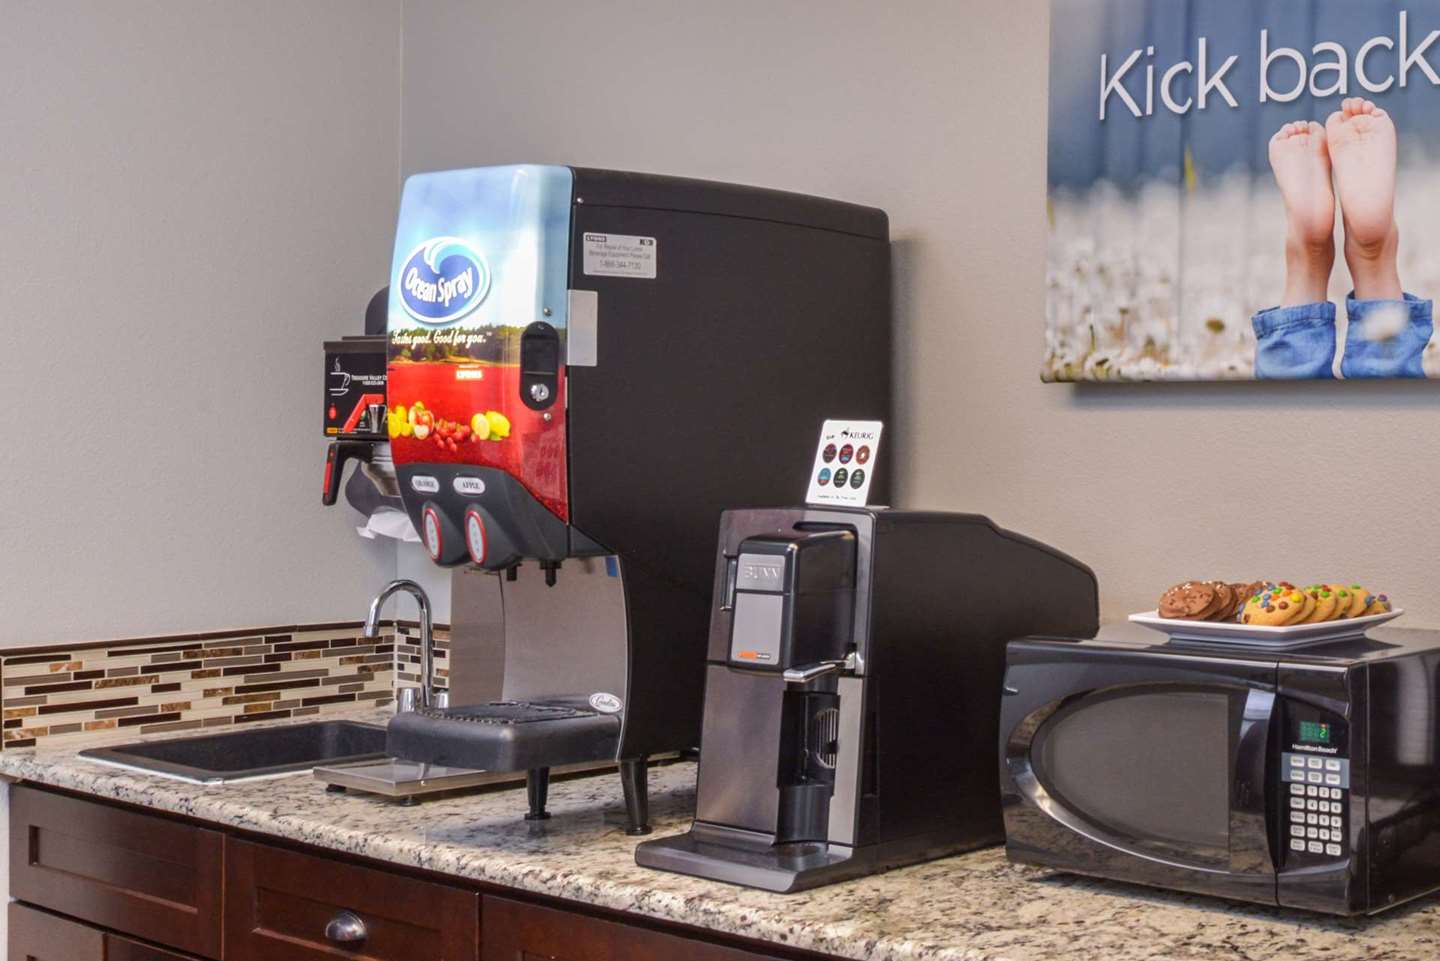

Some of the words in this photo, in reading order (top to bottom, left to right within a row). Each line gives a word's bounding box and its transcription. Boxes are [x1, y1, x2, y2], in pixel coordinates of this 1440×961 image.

[1098, 37, 1239, 121] Kick
[405, 266, 437, 303] Ocean
[438, 266, 473, 307] Spray
[433, 329, 454, 344] Good
[453, 330, 466, 346] for
[849, 431, 874, 440] KEURIG
